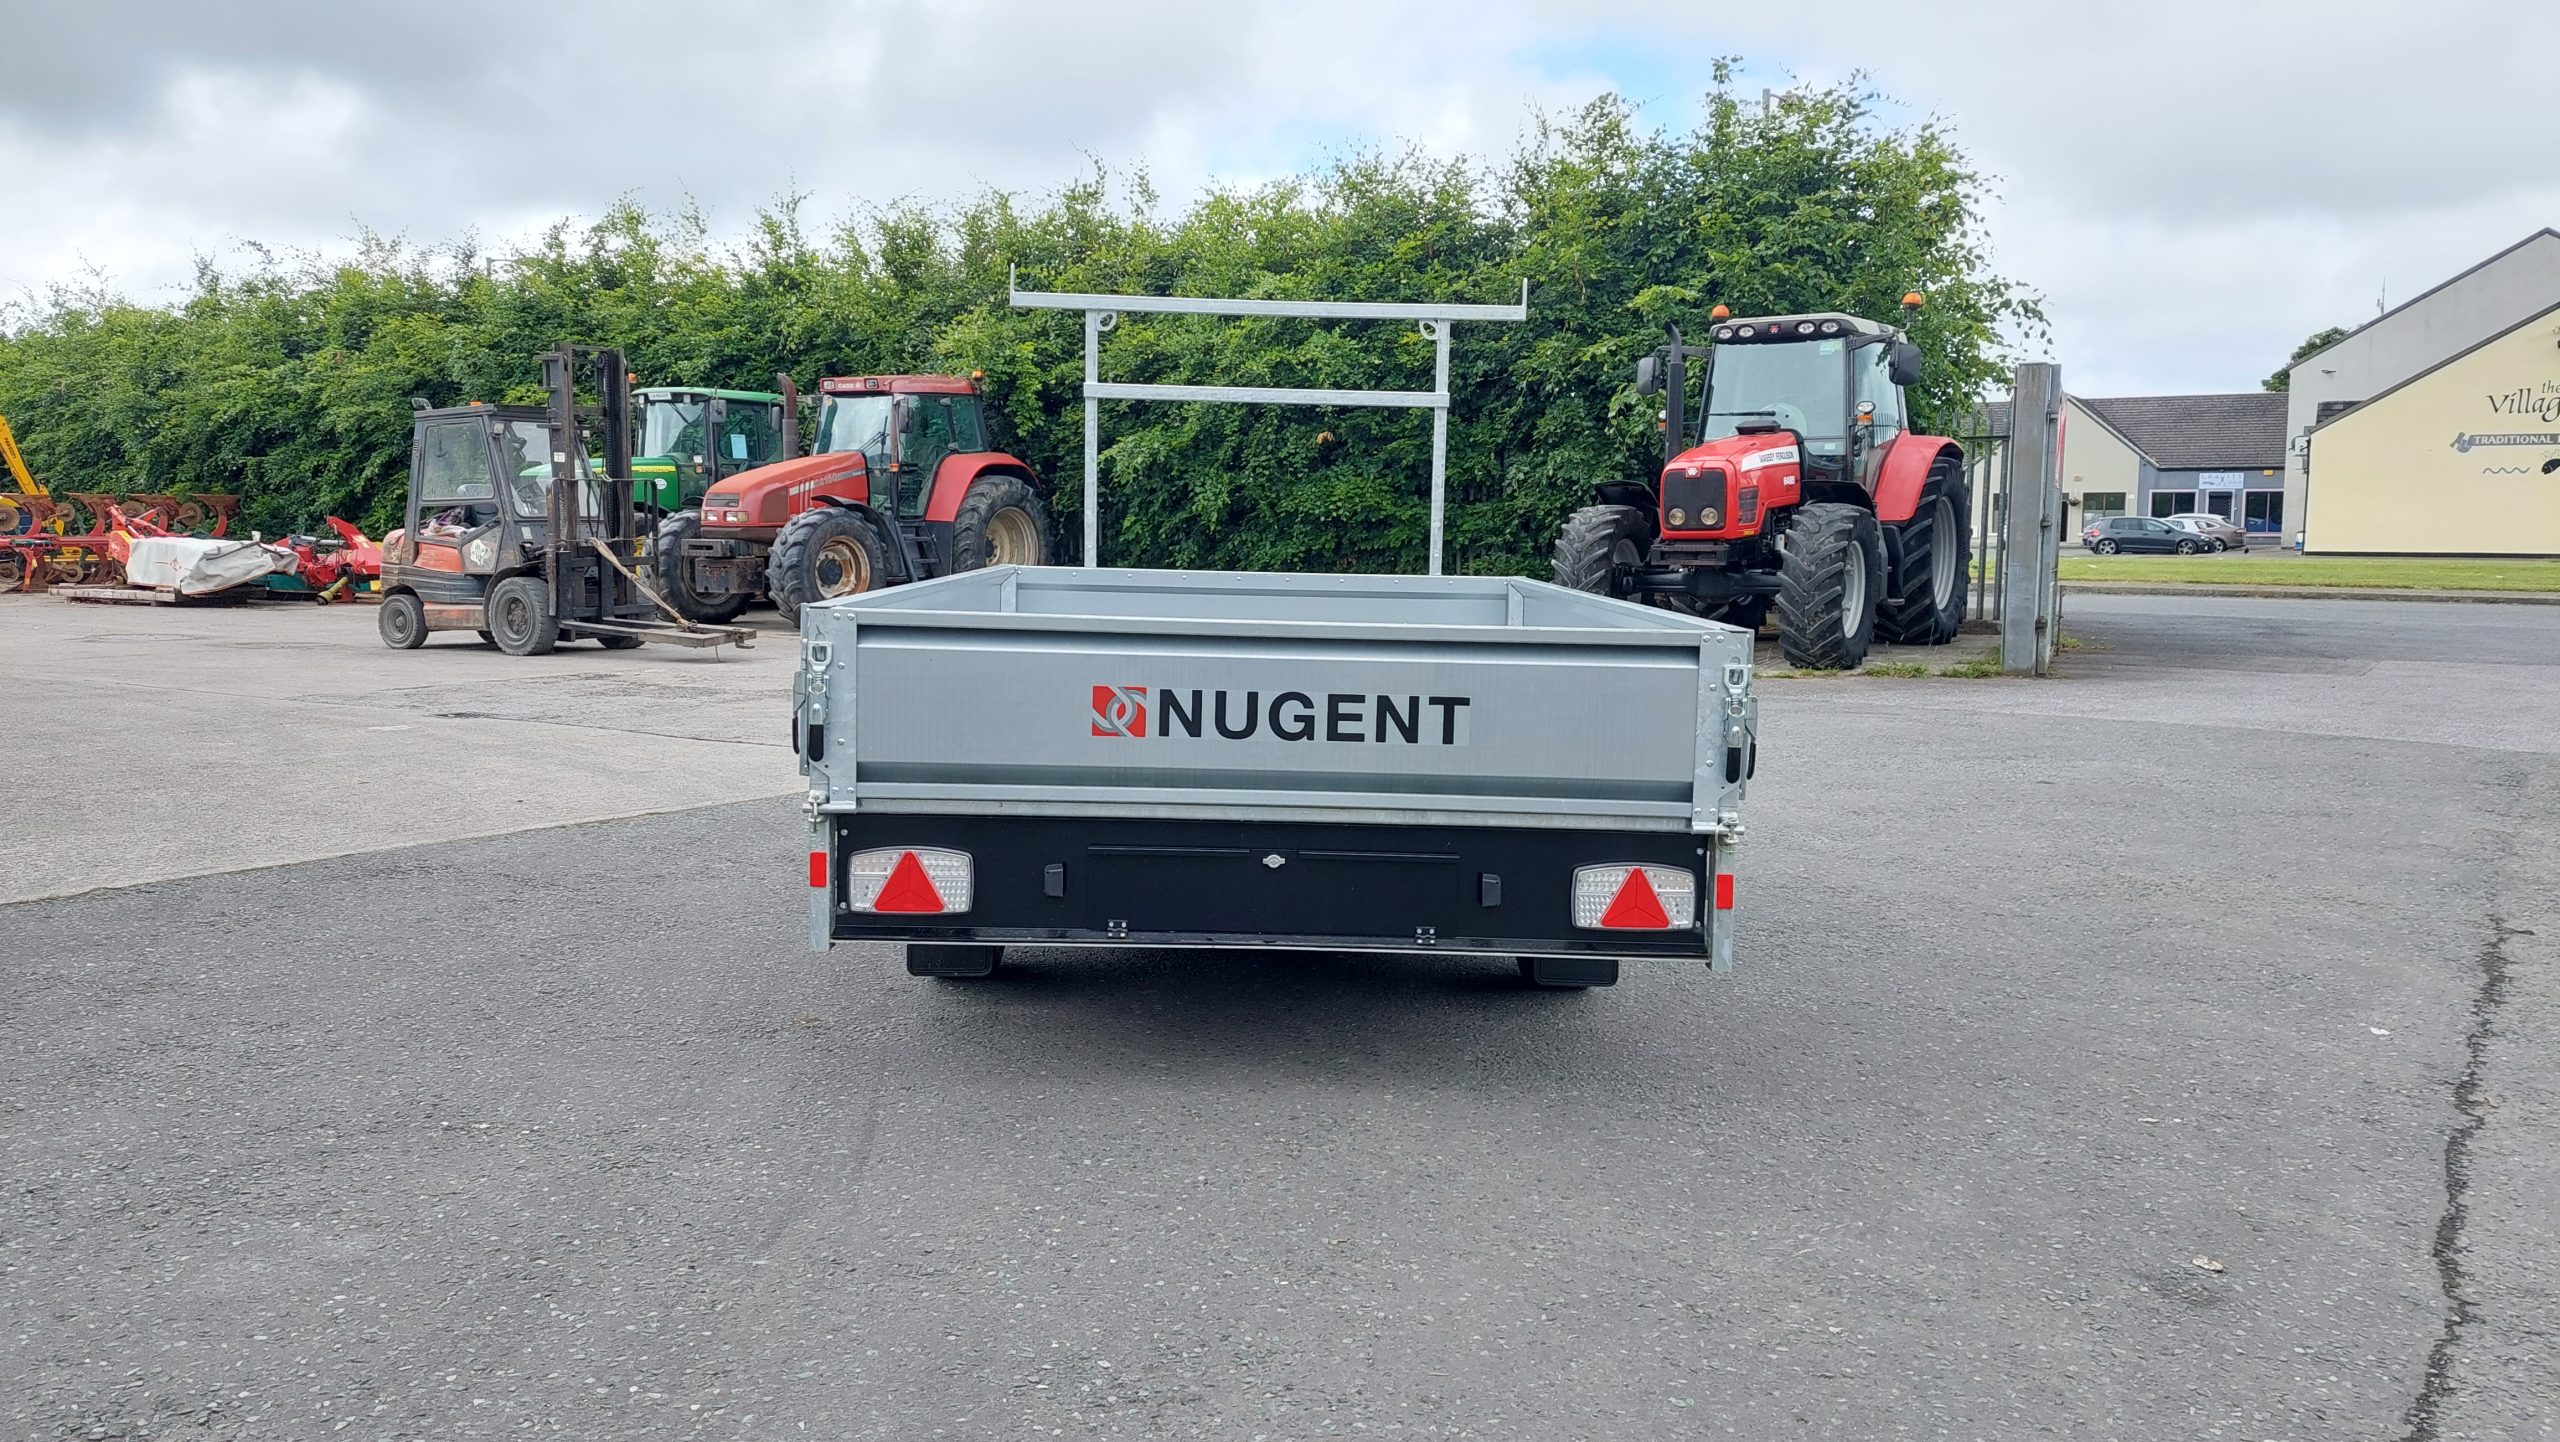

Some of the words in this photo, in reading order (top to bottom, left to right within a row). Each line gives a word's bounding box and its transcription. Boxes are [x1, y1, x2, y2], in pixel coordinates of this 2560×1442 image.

[2542, 379, 2560, 394] the
[2474, 435, 2553, 445] TRADITIONAL
[1158, 687, 1471, 745] NUGENT
